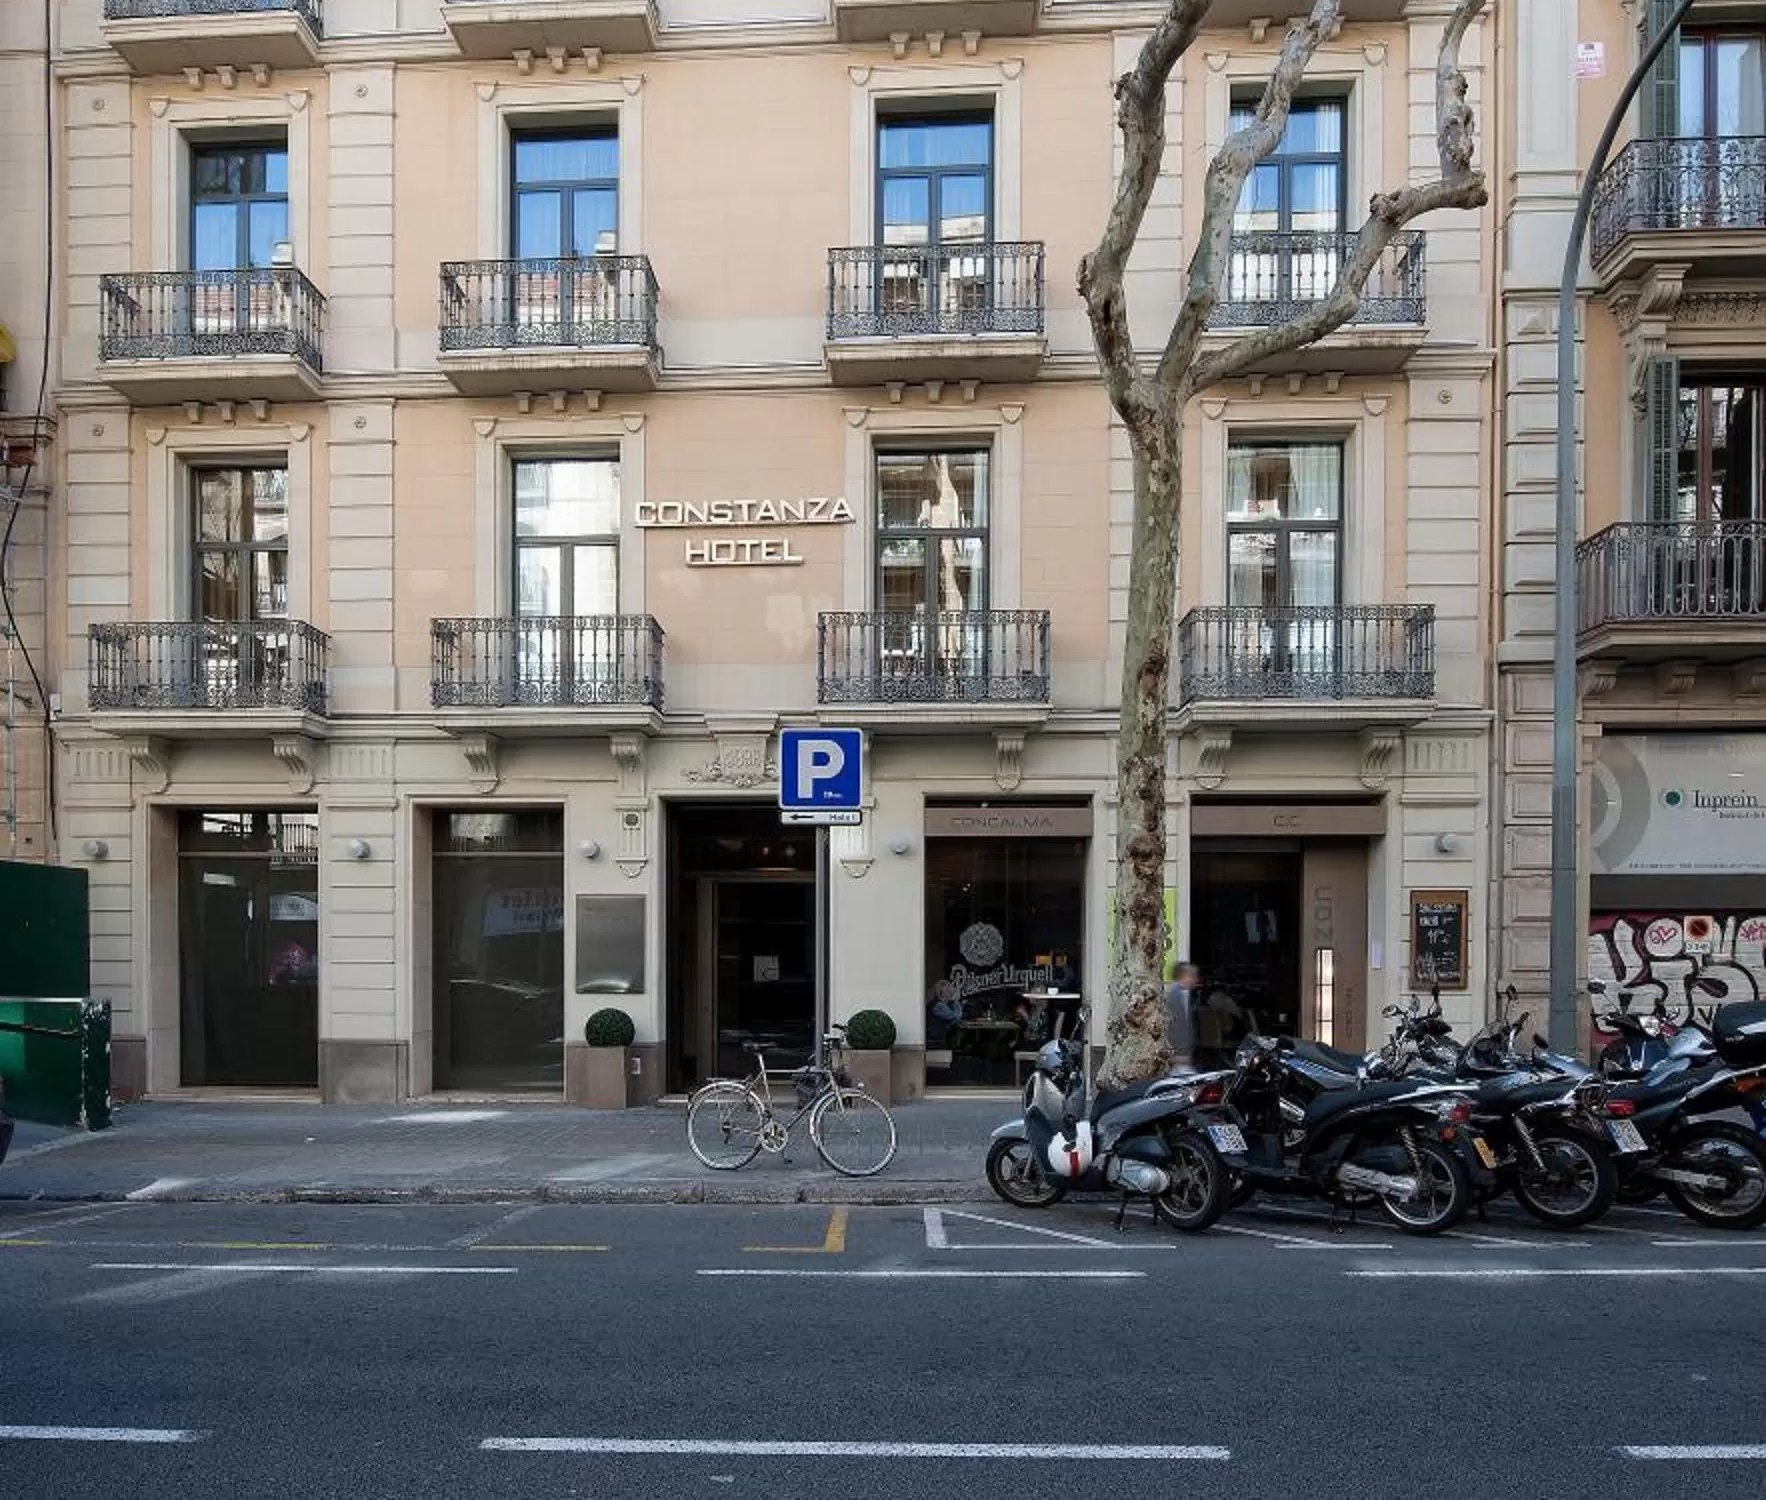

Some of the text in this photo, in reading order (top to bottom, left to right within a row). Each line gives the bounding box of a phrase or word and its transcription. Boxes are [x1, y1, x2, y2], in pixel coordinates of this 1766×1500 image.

[635, 497, 855, 524] CONSTANZA
[686, 539, 804, 563] HOTEL
[797, 739, 845, 799] P
[1692, 789, 1760, 812] Inprein
[949, 963, 1053, 1001] Pilsner Urquell
